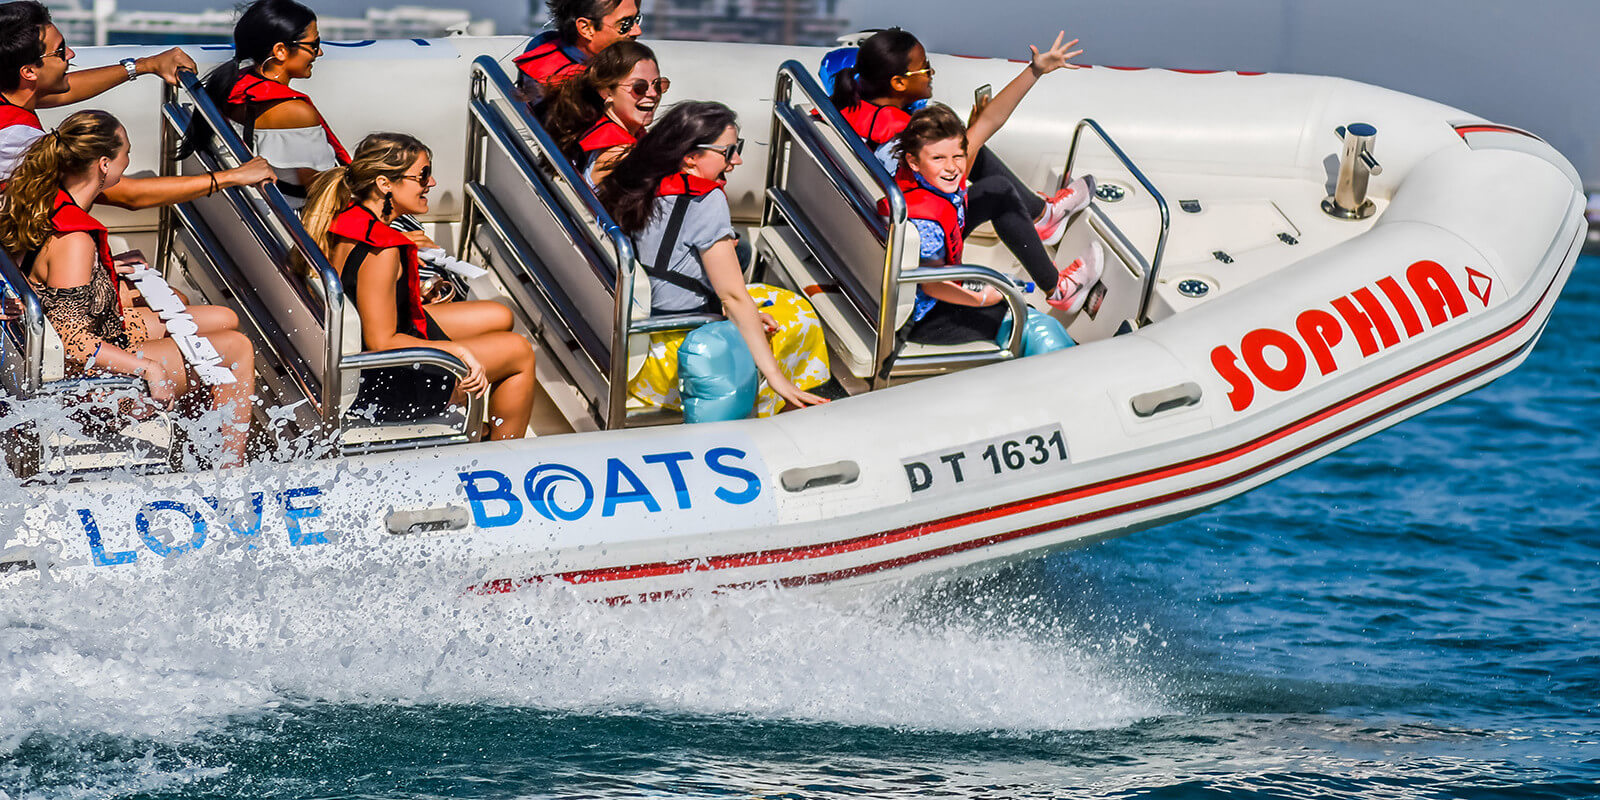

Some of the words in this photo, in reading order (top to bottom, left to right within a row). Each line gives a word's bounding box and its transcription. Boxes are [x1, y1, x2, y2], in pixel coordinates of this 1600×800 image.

[1210, 260, 1468, 412] SOPHIA
[76, 486, 335, 567] LOVE
[457, 446, 762, 529] BOATS
[982, 430, 1068, 475] 1631
